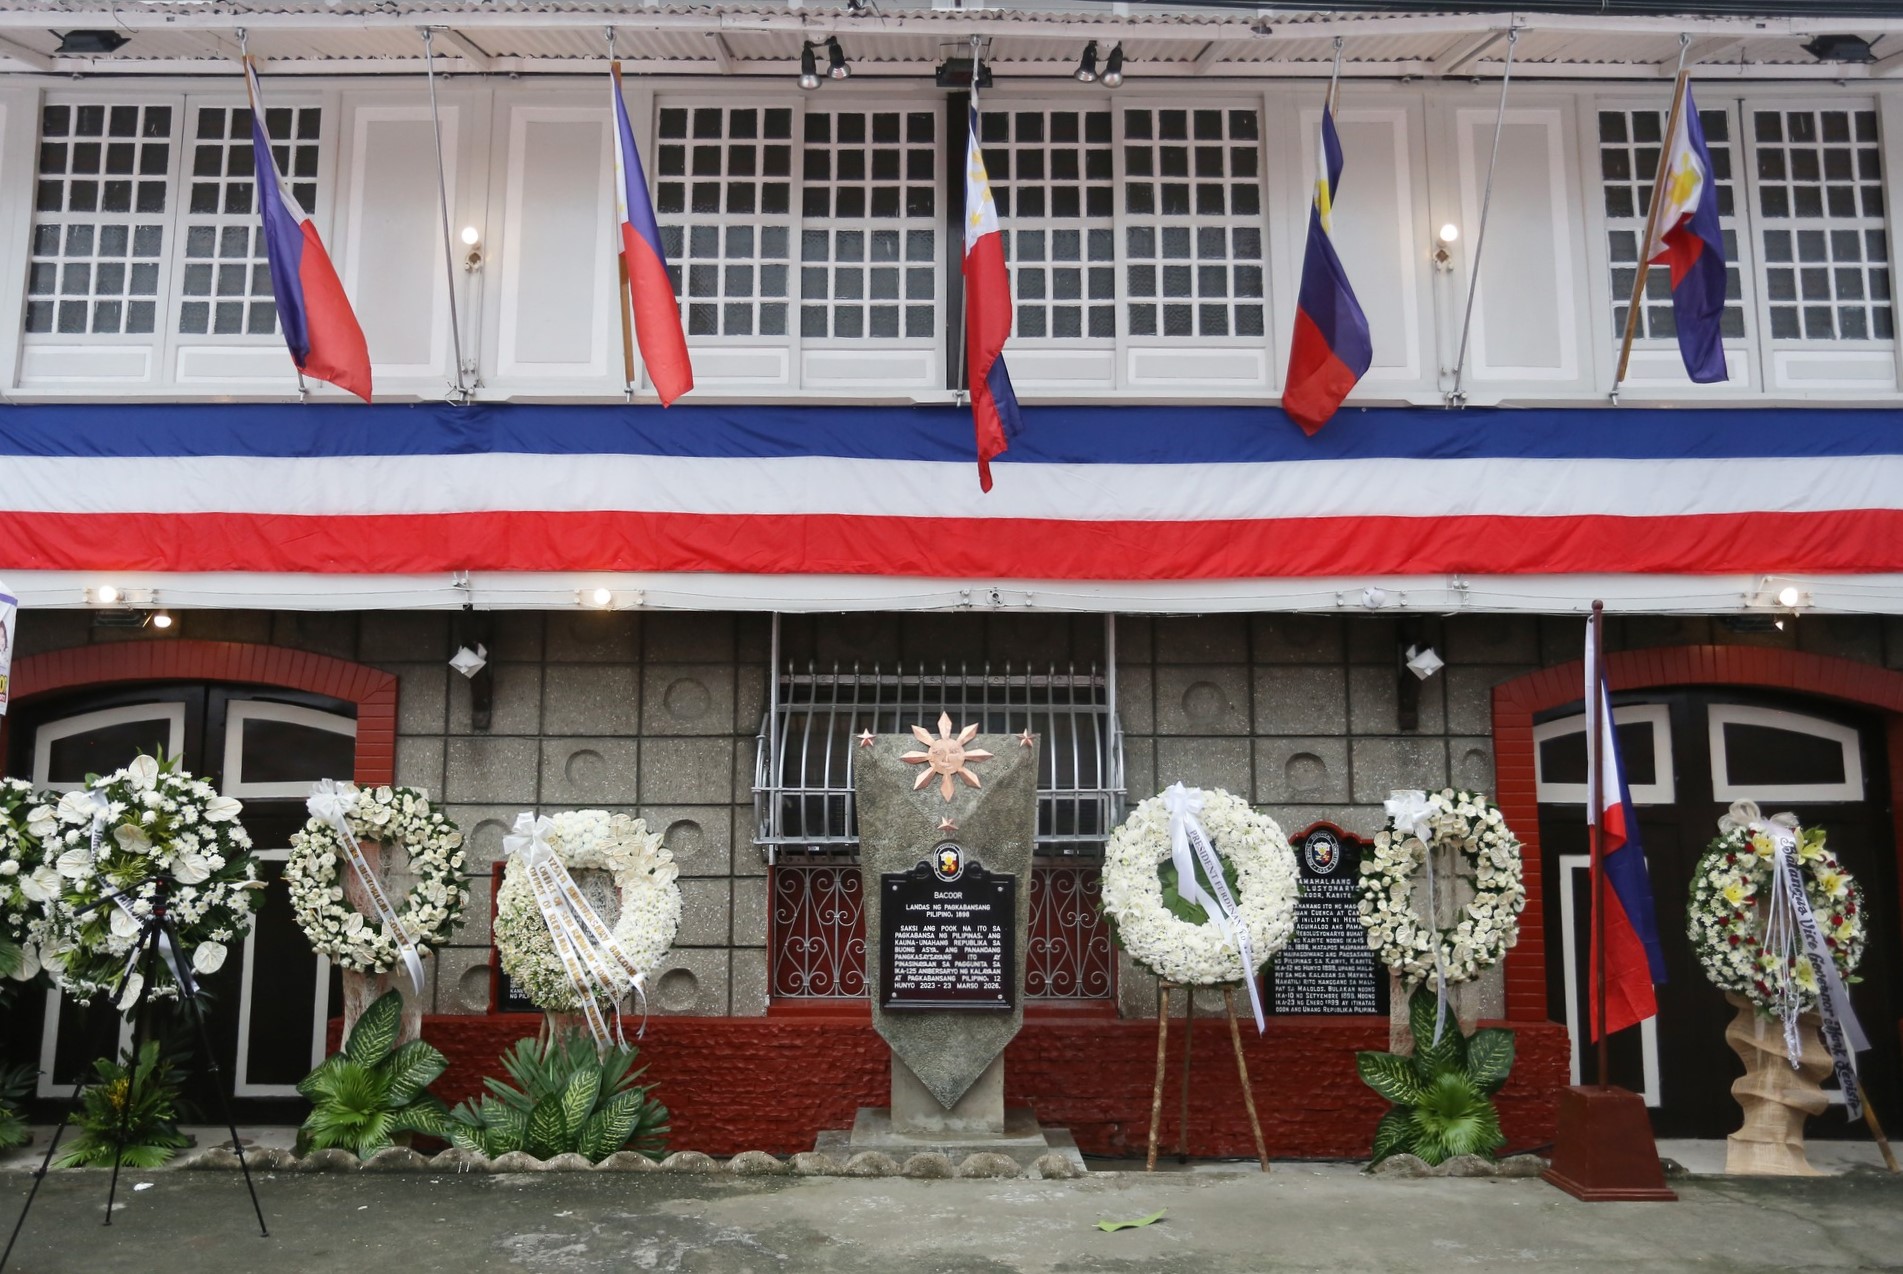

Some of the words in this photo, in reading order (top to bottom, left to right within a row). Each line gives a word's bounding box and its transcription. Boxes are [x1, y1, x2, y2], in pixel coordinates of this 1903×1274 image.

[342, 832, 359, 858] FROM
[358, 864, 390, 913] HISTORICAL
[529, 866, 546, 896] OFFICE
[538, 866, 556, 894] OFFICE
[554, 896, 563, 906] OF
[1190, 830, 1218, 879] PRESIDENT
[1214, 880, 1241, 927] FERDINAN
[1780, 837, 1808, 916] Batangas
[566, 885, 610, 941] ANNIVERSARY
[609, 944, 638, 977] BACOOR
[1800, 918, 1818, 950] Vice
[1807, 952, 1834, 1018] Governor
